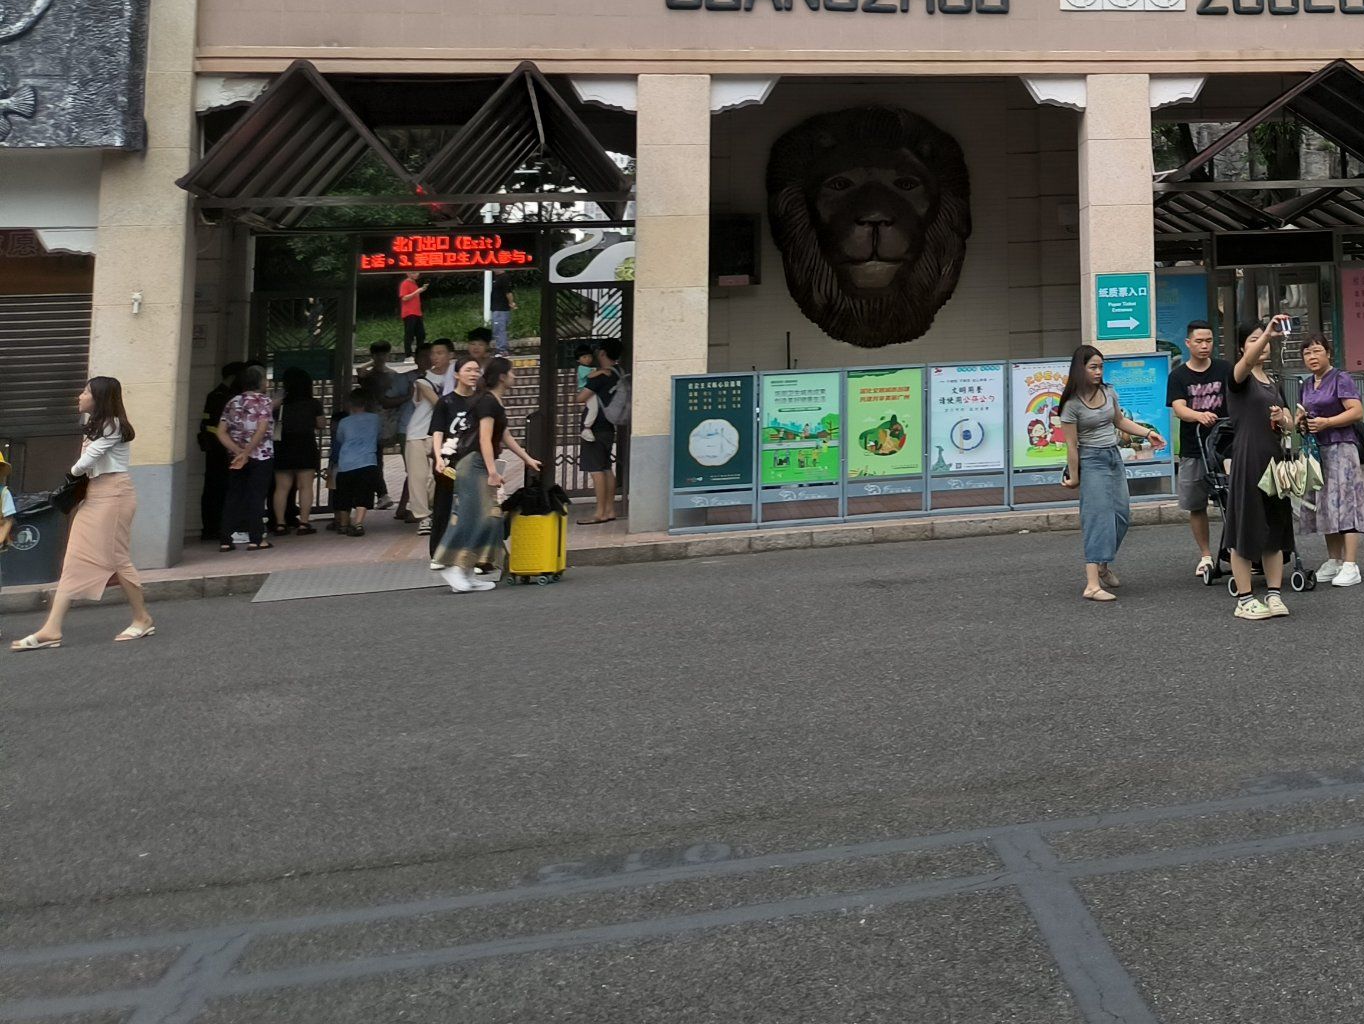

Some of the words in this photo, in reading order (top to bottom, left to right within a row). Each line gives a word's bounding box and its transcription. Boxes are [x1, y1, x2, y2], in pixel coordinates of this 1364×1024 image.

[1098, 287, 1148, 298] 纸质票入口
